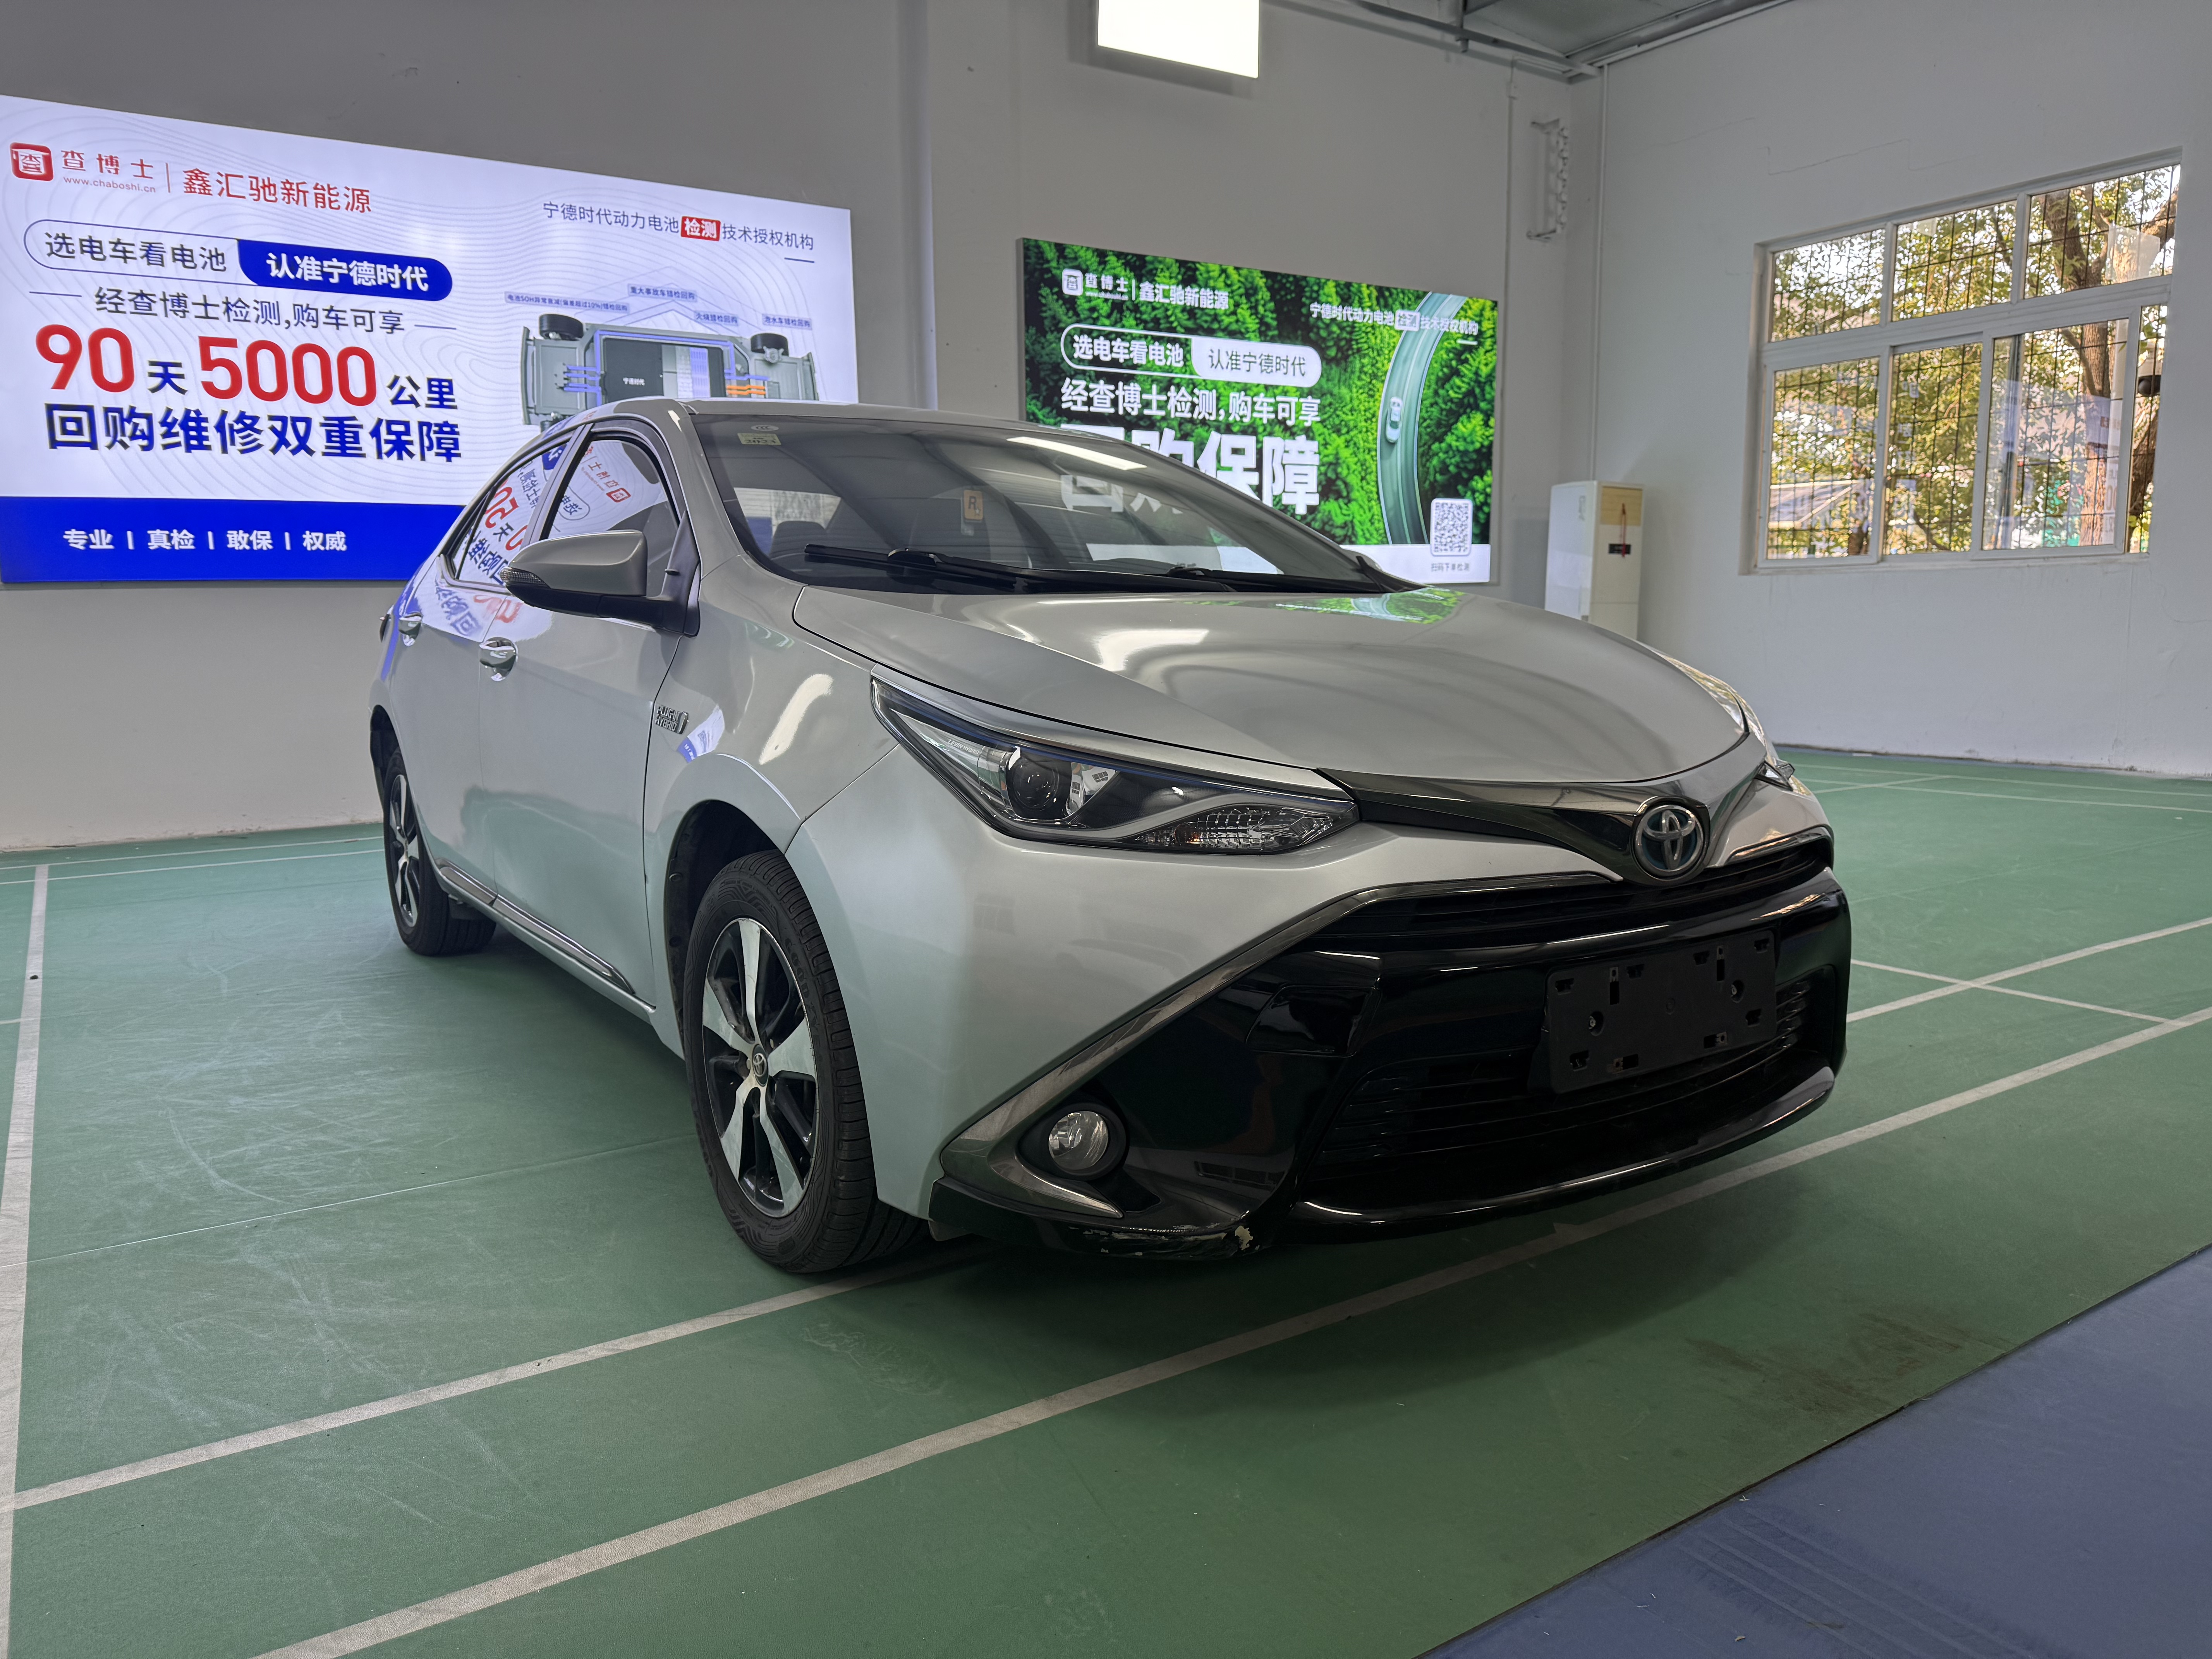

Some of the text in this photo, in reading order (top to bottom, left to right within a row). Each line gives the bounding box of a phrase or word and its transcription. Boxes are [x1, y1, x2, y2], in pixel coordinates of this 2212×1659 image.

[61, 150, 154, 179] 查博士
[182, 168, 372, 213] 鑫汇驰新能源
[63, 176, 156, 193] www.chaboshi.cn
[45, 232, 429, 291] 选电车看电池 认准宁德时代
[1139, 281, 1229, 310] 鑫汇驰新能源
[1073, 334, 1306, 377] 选电车看电池 认准宁德时代
[44, 402, 461, 463] 回购维修双重保障
[63, 528, 347, 552] 专业 真检 敢保 权威
[655, 716, 677, 732] HYBRID
[948, 739, 964, 749] LEVIN
